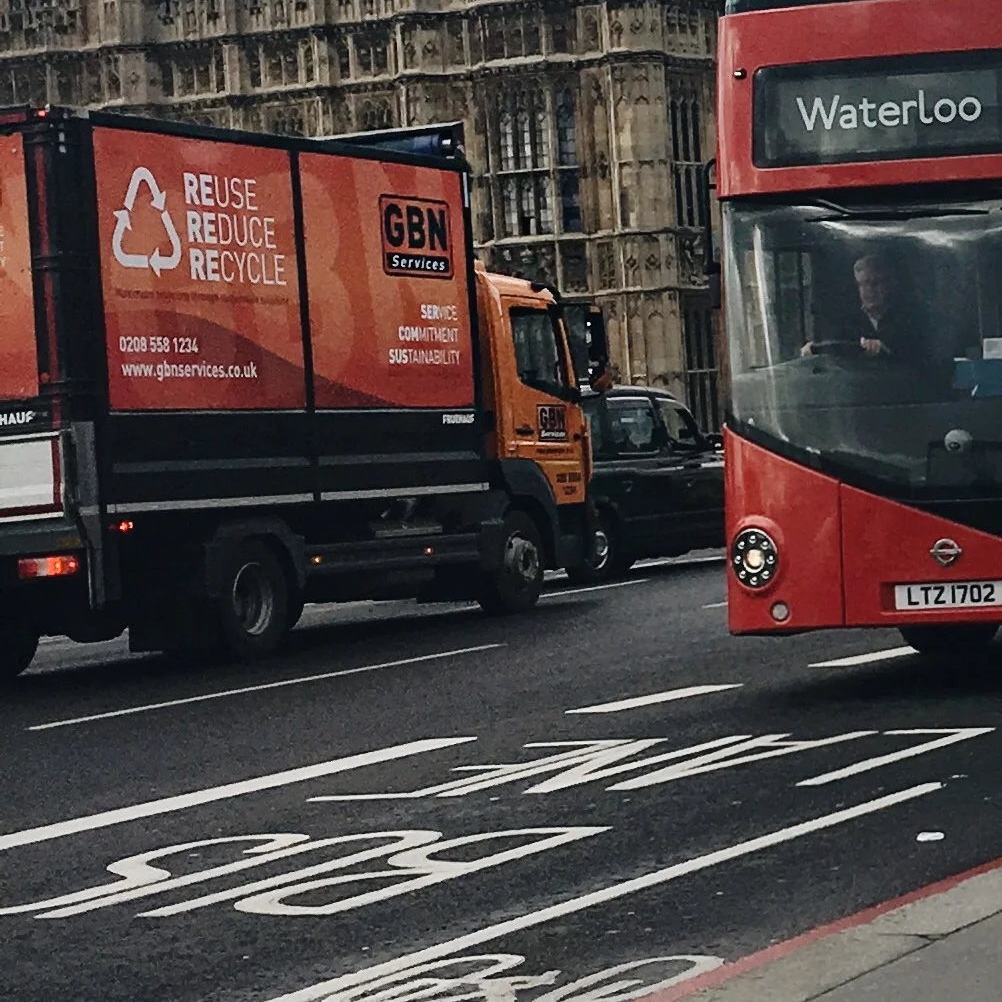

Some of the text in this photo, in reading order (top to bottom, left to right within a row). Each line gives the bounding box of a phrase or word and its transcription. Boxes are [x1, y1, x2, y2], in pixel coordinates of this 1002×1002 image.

[796, 89, 982, 132] Waterloo
[183, 172, 259, 211] REUSE
[187, 210, 277, 249] REDUCE
[384, 203, 448, 252] GBN
[189, 248, 287, 286] RECYCLE
[392, 254, 446, 272] Services
[420, 304, 458, 321] SERVICE
[119, 335, 199, 353] 0208 558 1234
[398, 325, 459, 343] COMMITMENT
[389, 349, 460, 366] SUSTAINABILITY
[121, 361, 258, 382] www.gbnservices.co.uk
[539, 407, 567, 429] GBN
[907, 583, 996, 606] LTZ 1702
